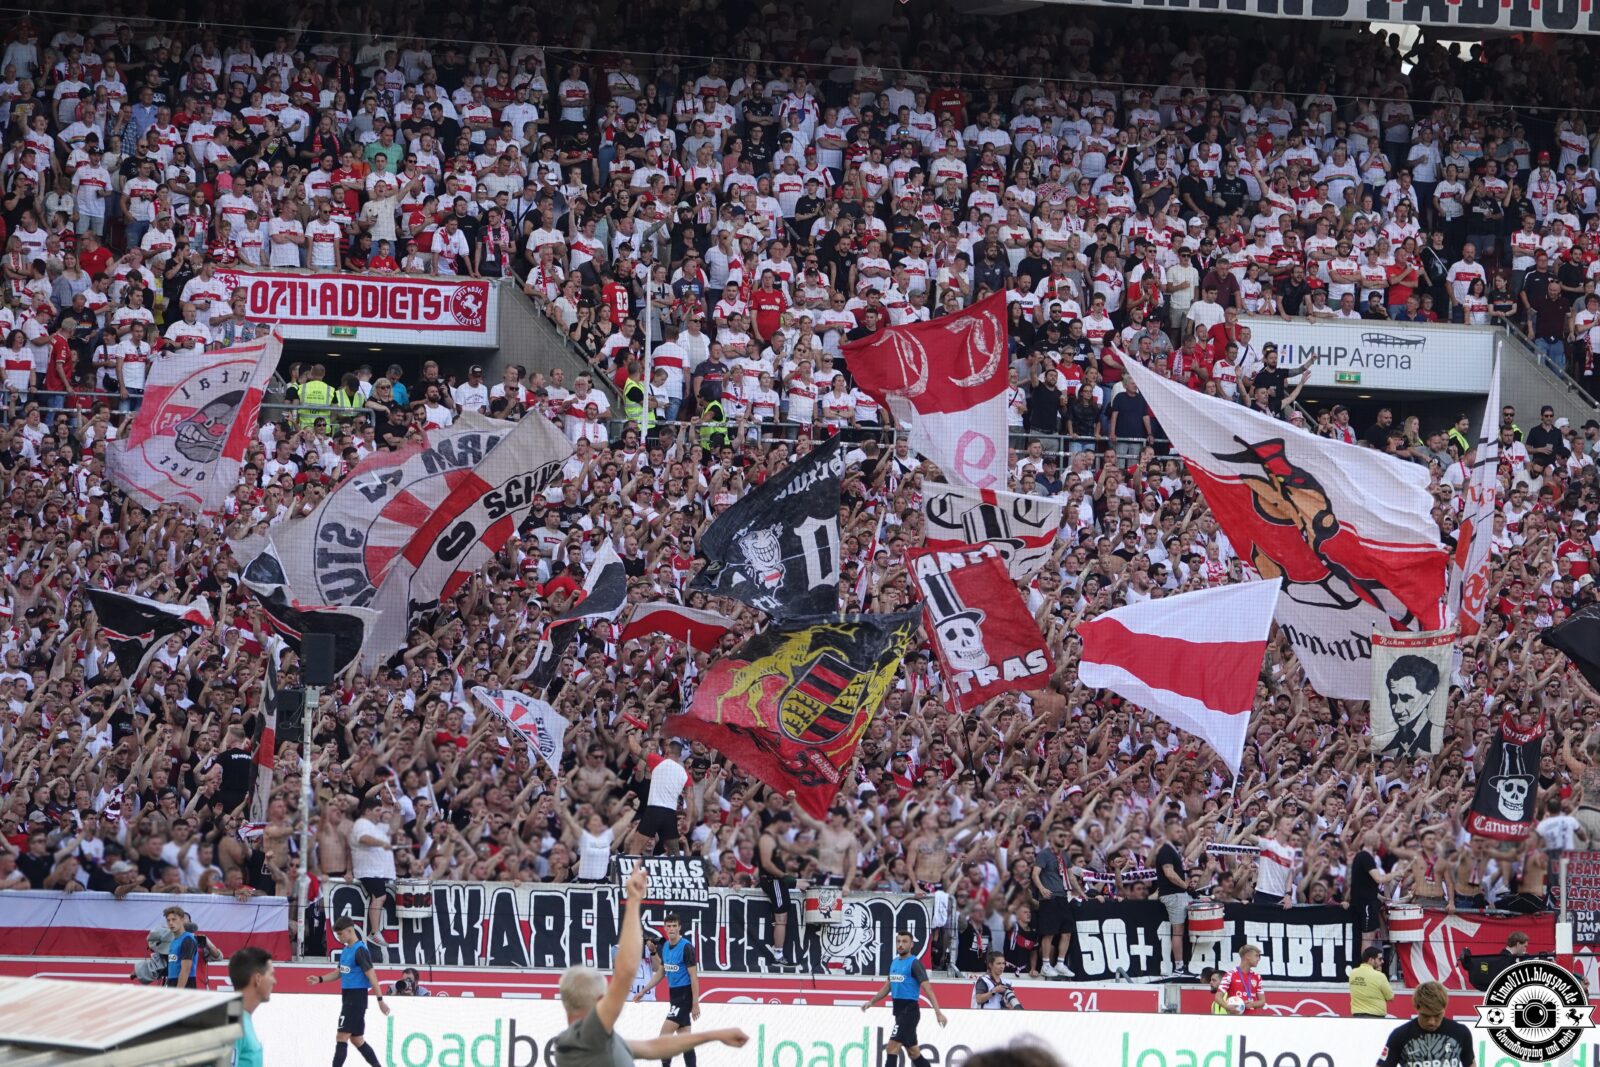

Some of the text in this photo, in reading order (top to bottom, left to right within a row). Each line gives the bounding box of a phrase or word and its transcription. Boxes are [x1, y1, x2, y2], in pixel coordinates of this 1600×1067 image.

[251, 281, 308, 316] 0711
[1299, 344, 1412, 370] MHP Arena
[1551, 860, 1600, 874] VRBAN
[621, 875, 706, 889] BDEUTET
[1577, 911, 1594, 921] DU
[1069, 991, 1099, 1012] 34
